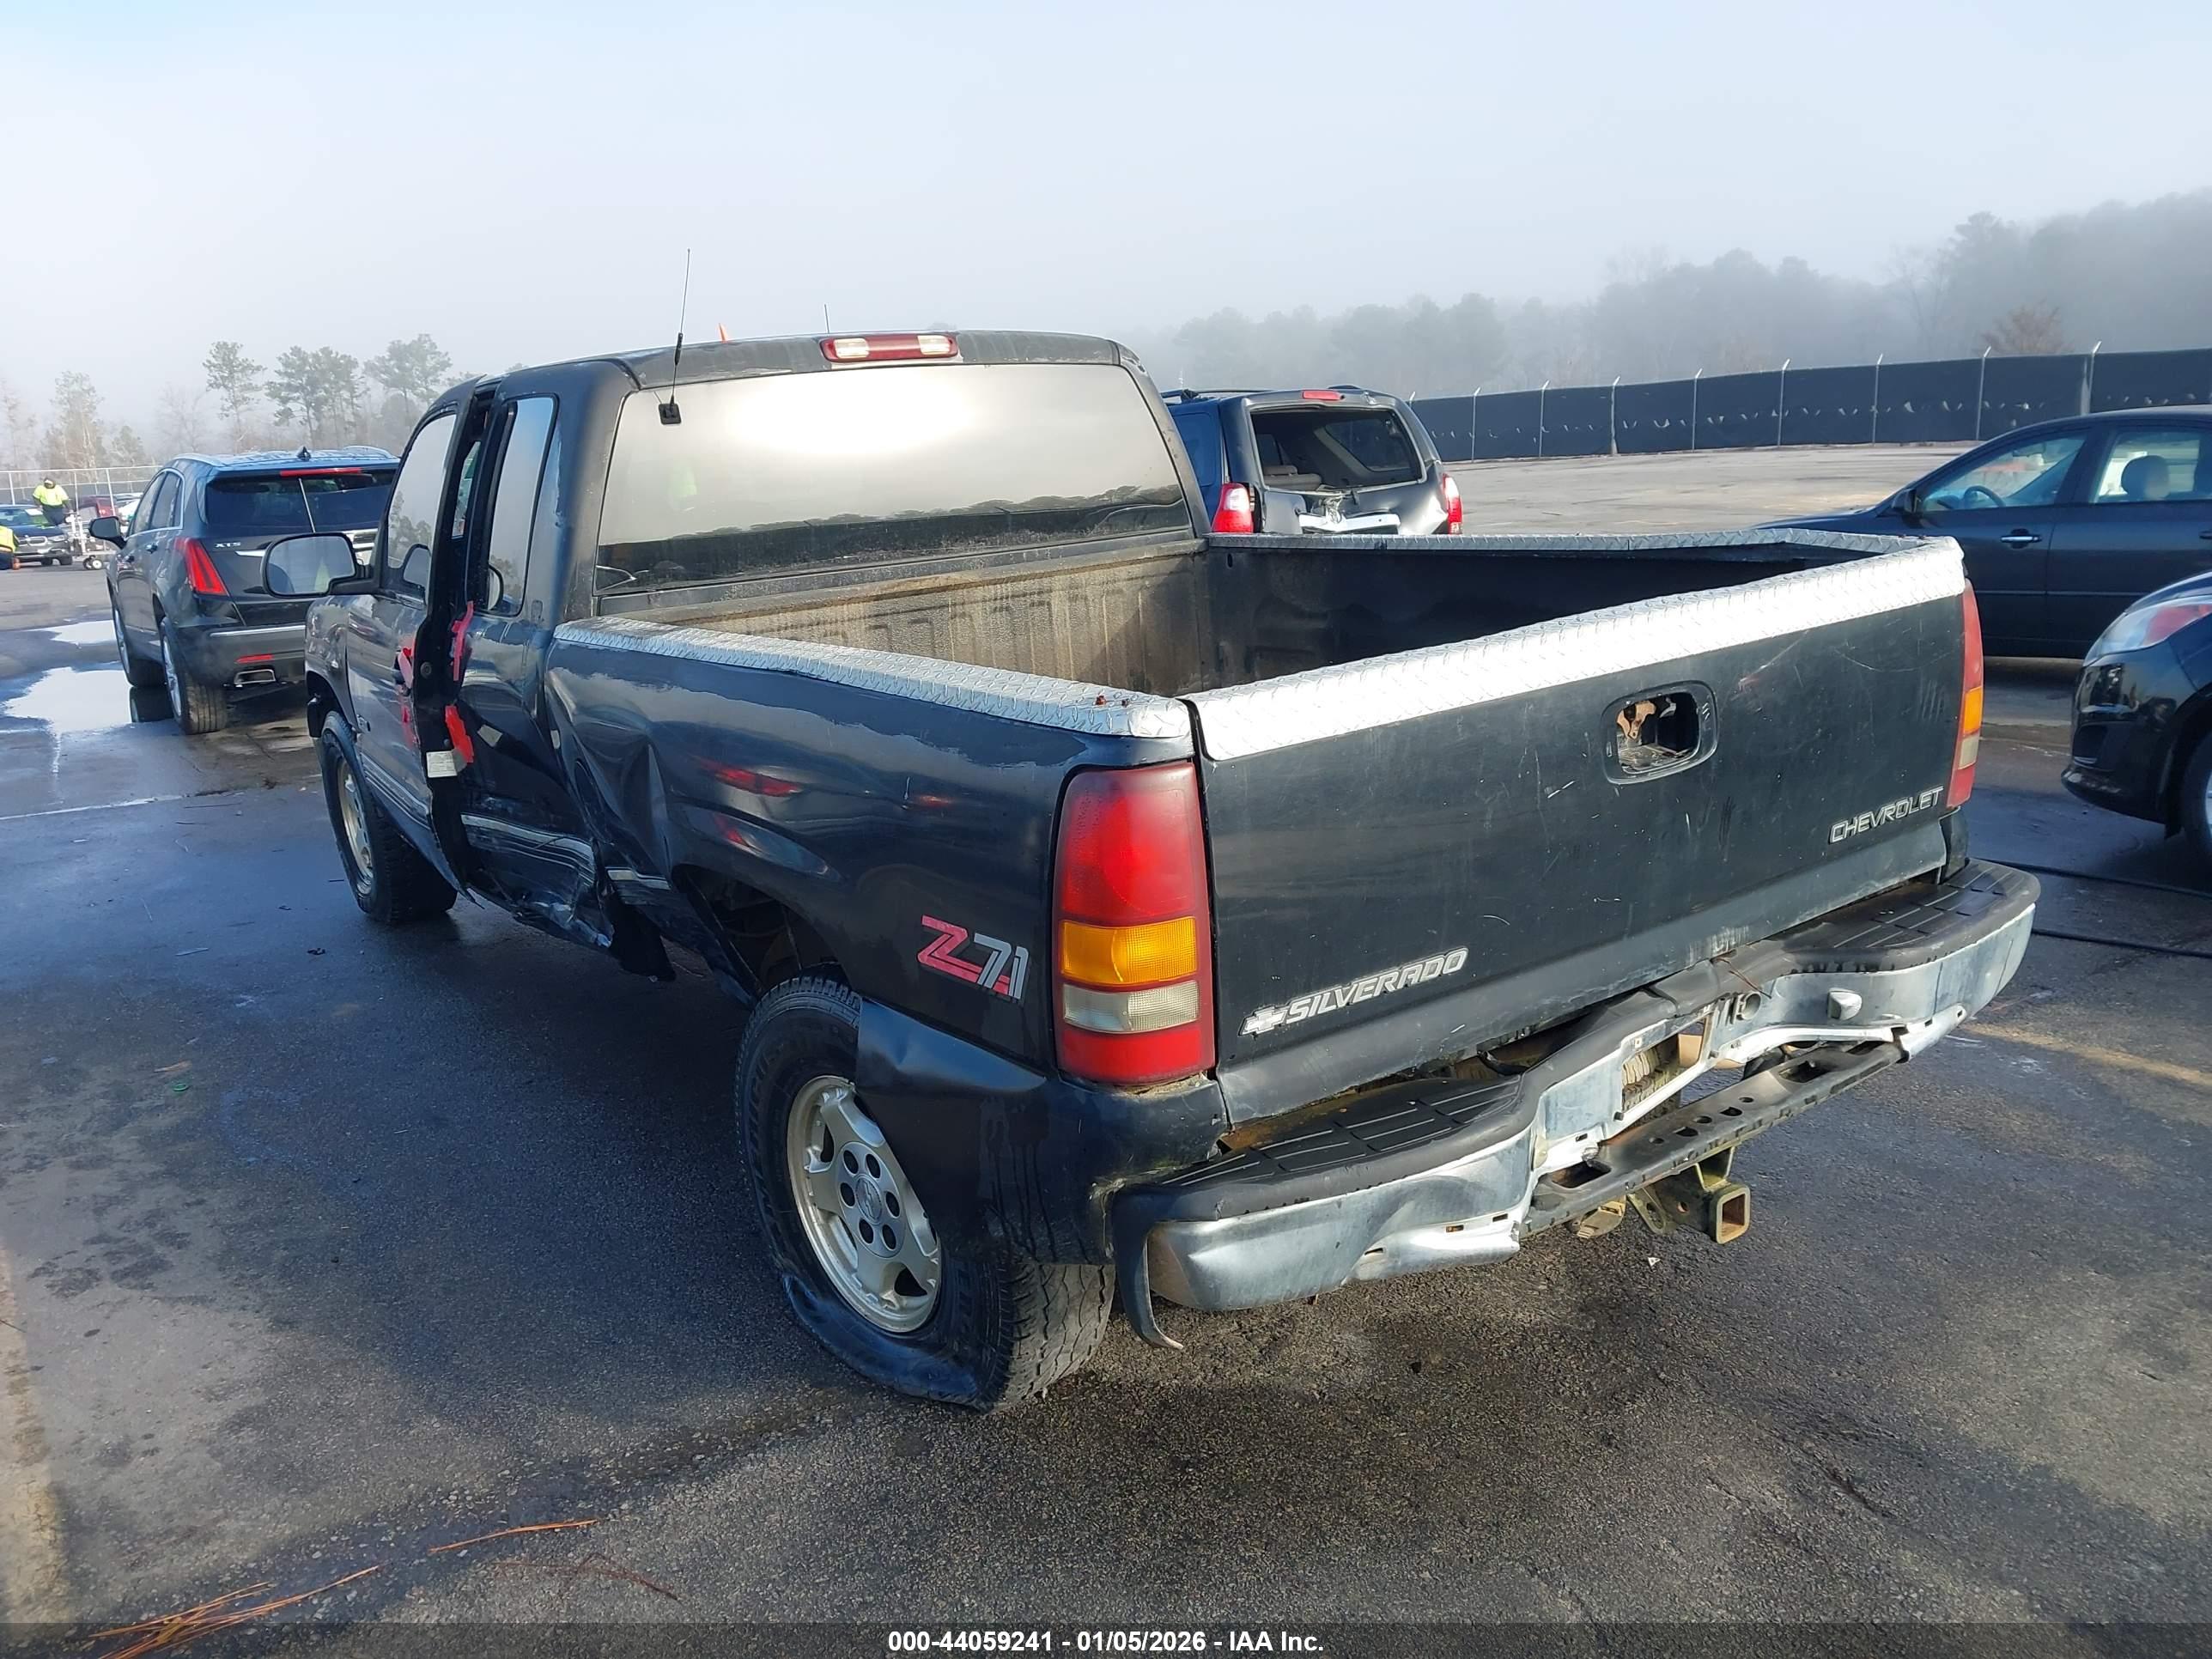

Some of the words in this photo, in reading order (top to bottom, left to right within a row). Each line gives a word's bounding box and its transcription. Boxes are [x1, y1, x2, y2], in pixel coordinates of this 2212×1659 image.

[1828, 785, 1944, 844] CHEVROLET
[916, 915, 1030, 1000] Z71
[1285, 947, 1468, 1025] SILVERADO
